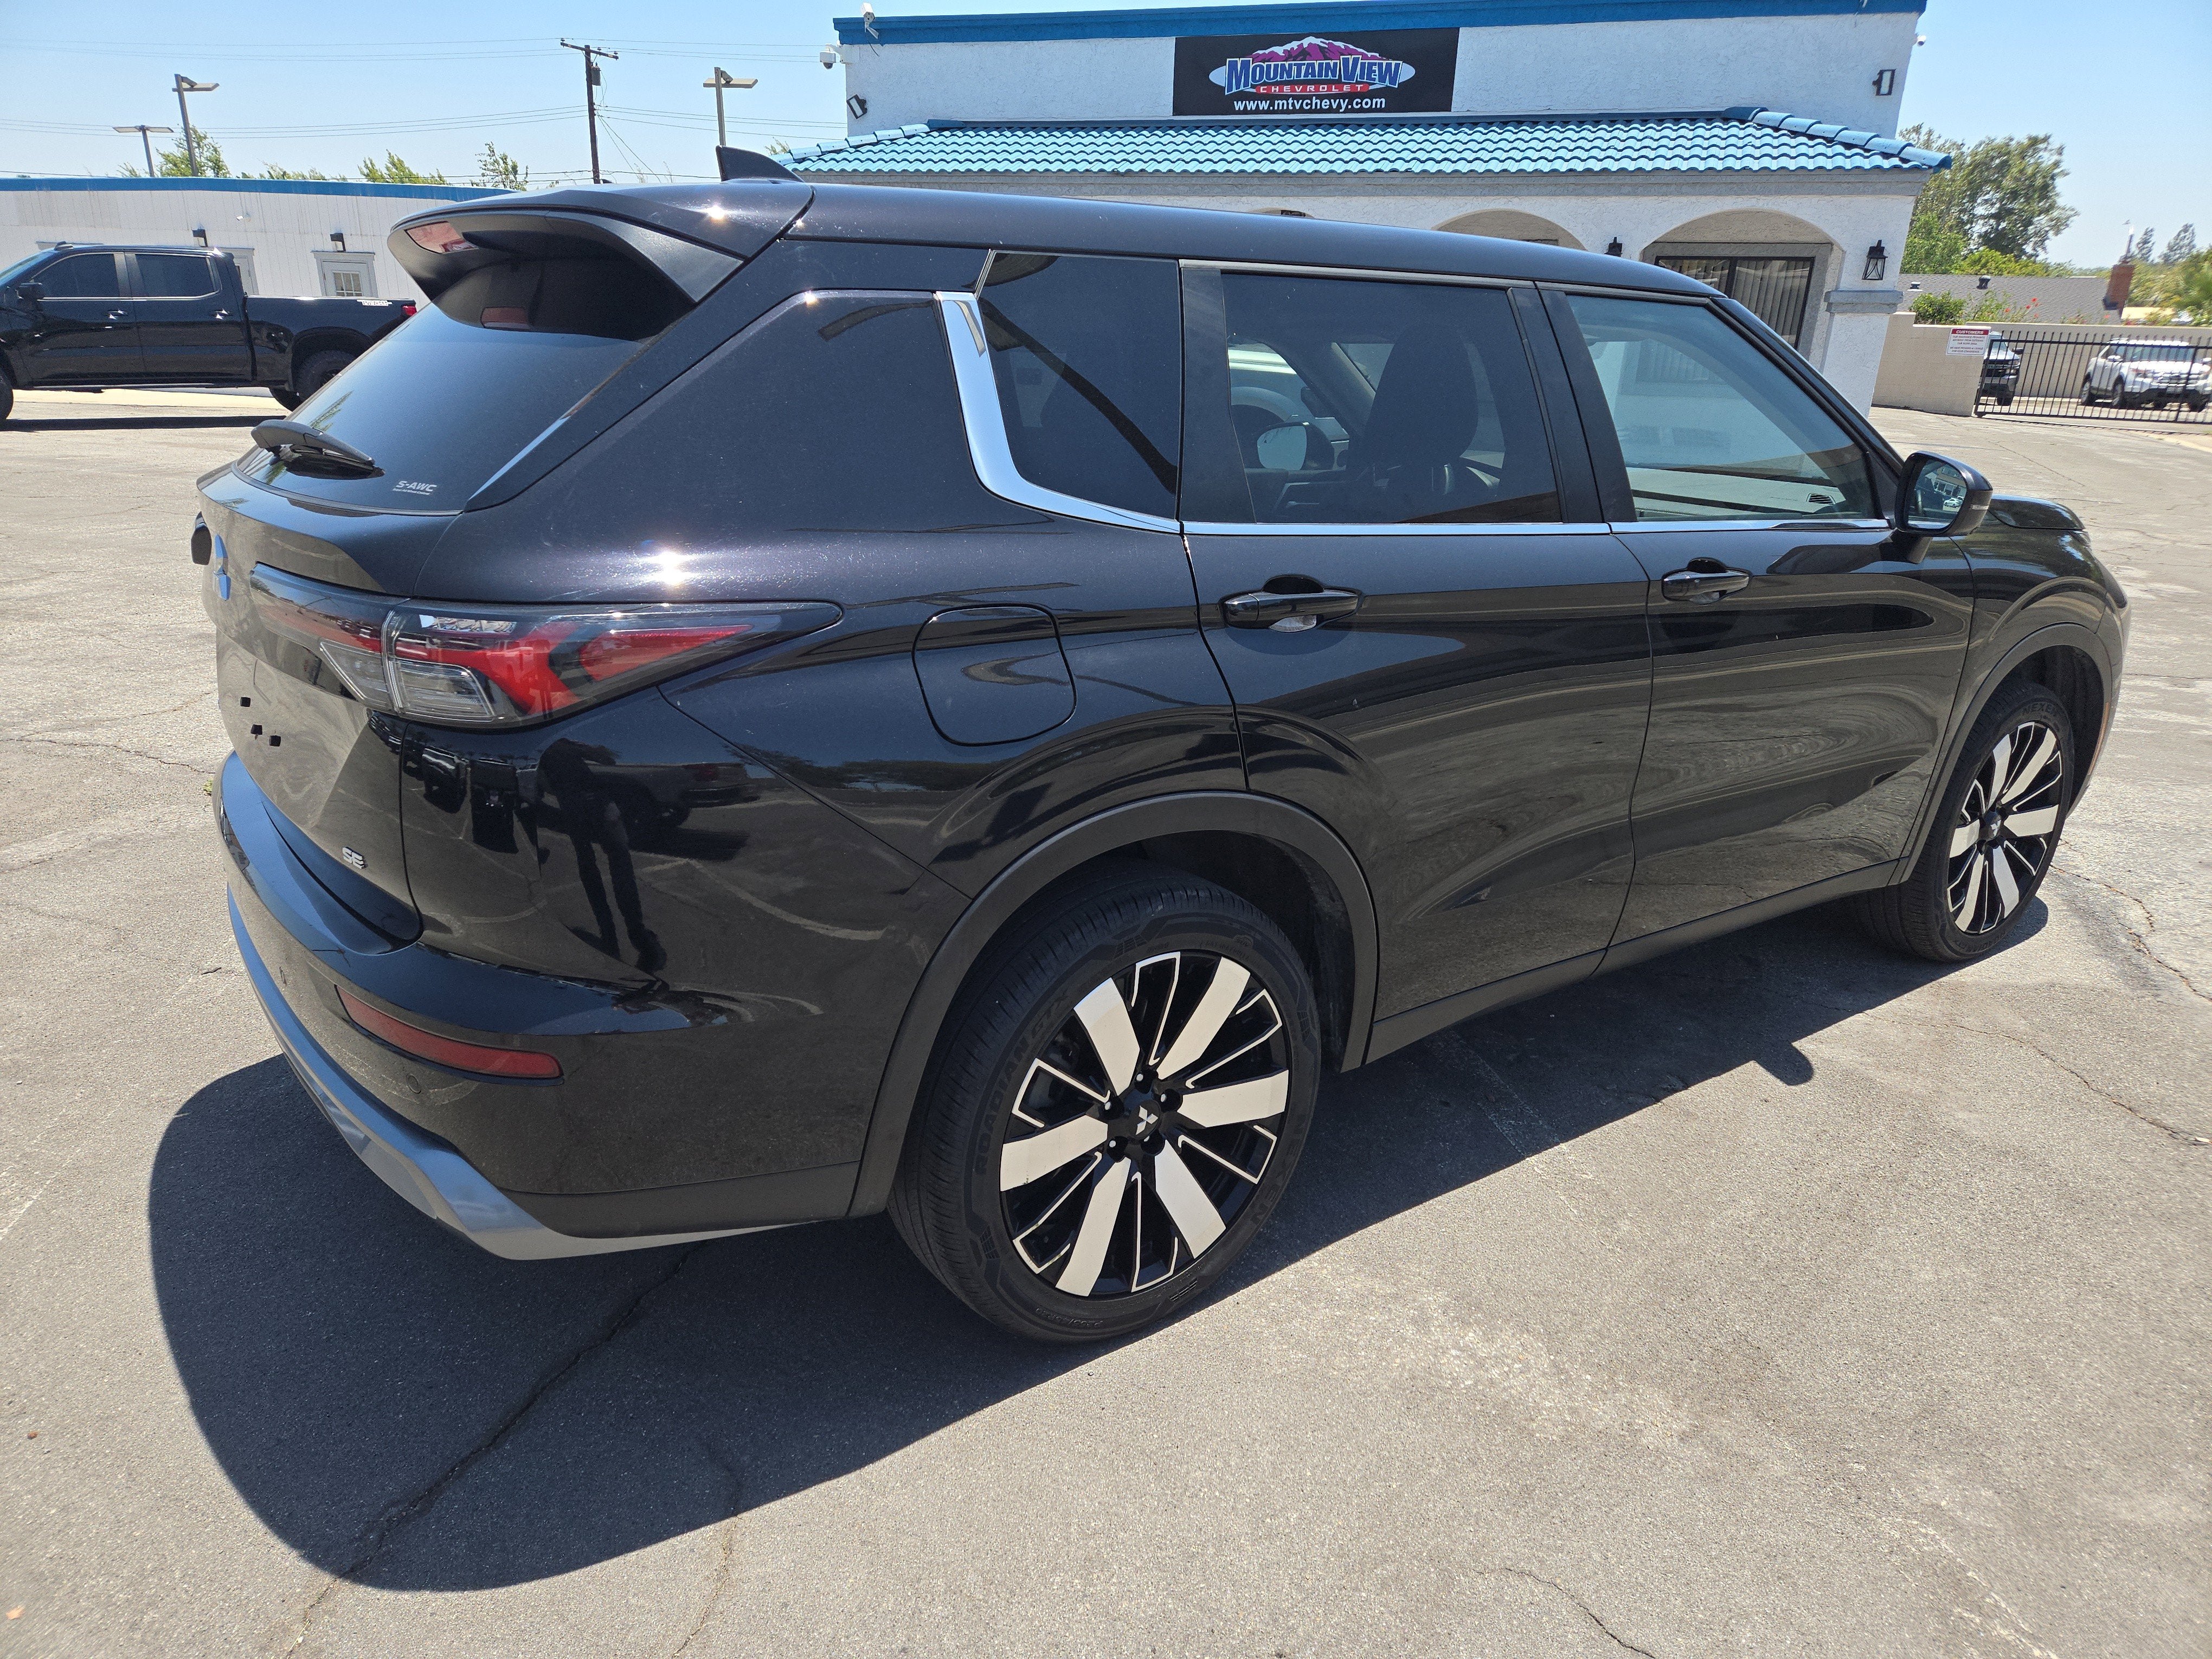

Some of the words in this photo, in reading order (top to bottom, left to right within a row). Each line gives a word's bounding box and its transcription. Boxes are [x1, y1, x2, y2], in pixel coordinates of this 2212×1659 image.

[1225, 58, 1341, 95] MOUNTAIN
[1341, 55, 1402, 88] VIEW
[1259, 83, 1364, 93] CHEVROLET
[1234, 96, 1386, 112] www.mtvchevy.com
[395, 480, 437, 492] S-AWC
[342, 847, 365, 870] SE
